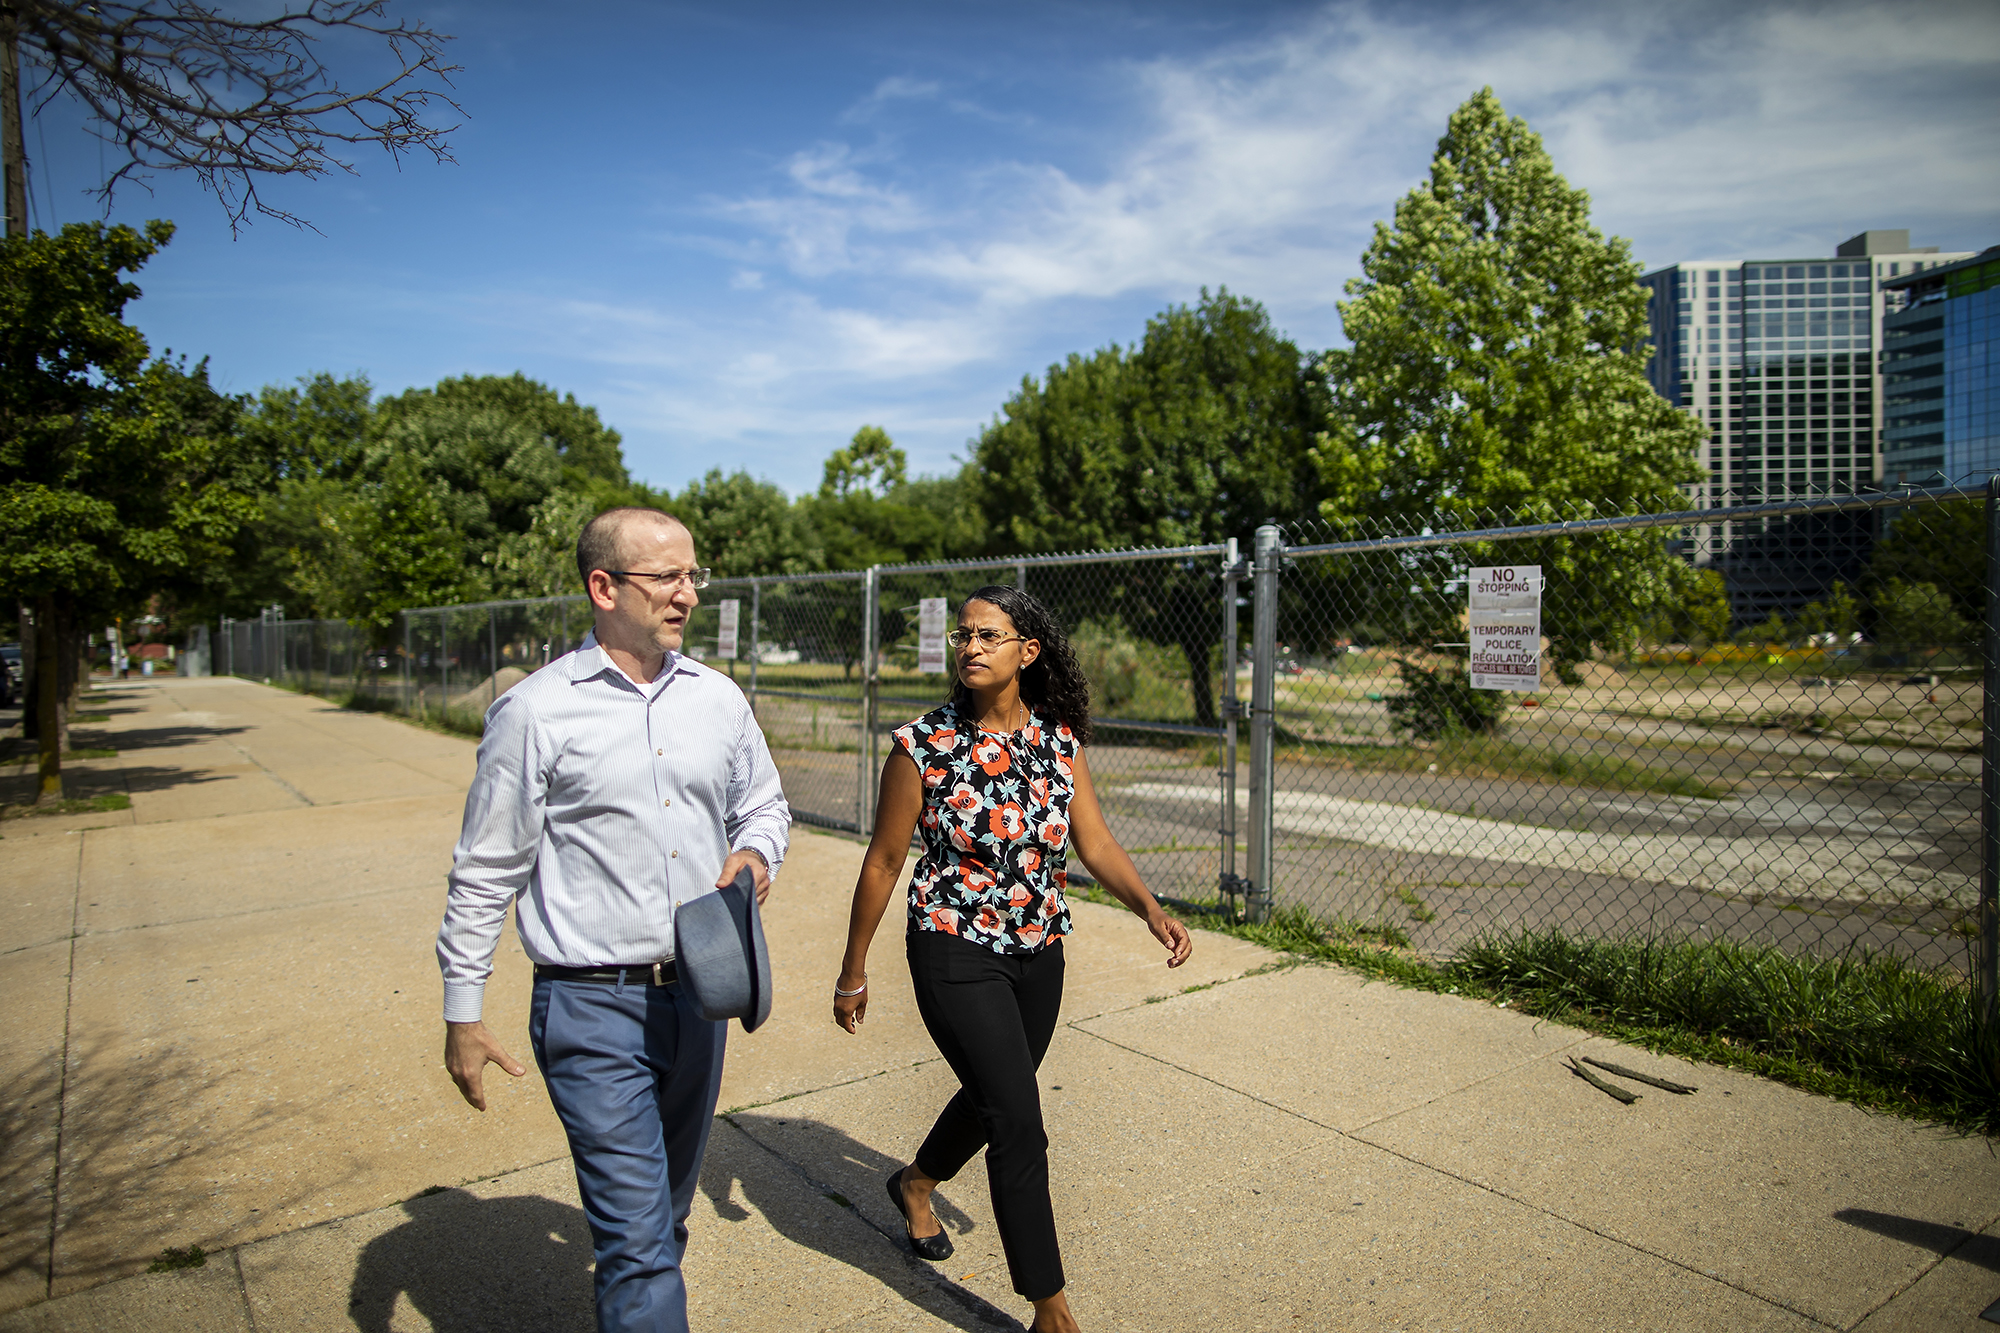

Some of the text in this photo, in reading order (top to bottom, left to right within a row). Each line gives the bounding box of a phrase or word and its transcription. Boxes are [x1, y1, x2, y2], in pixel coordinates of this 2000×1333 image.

[1492, 568, 1515, 582] NO
[1477, 582, 1530, 593] STOPPING
[1473, 625, 1536, 636] TEMPORARY
[1485, 639, 1522, 650] POLICE
[1473, 653, 1536, 664] REGULATION
[1473, 664, 1497, 673] VEHICLES
